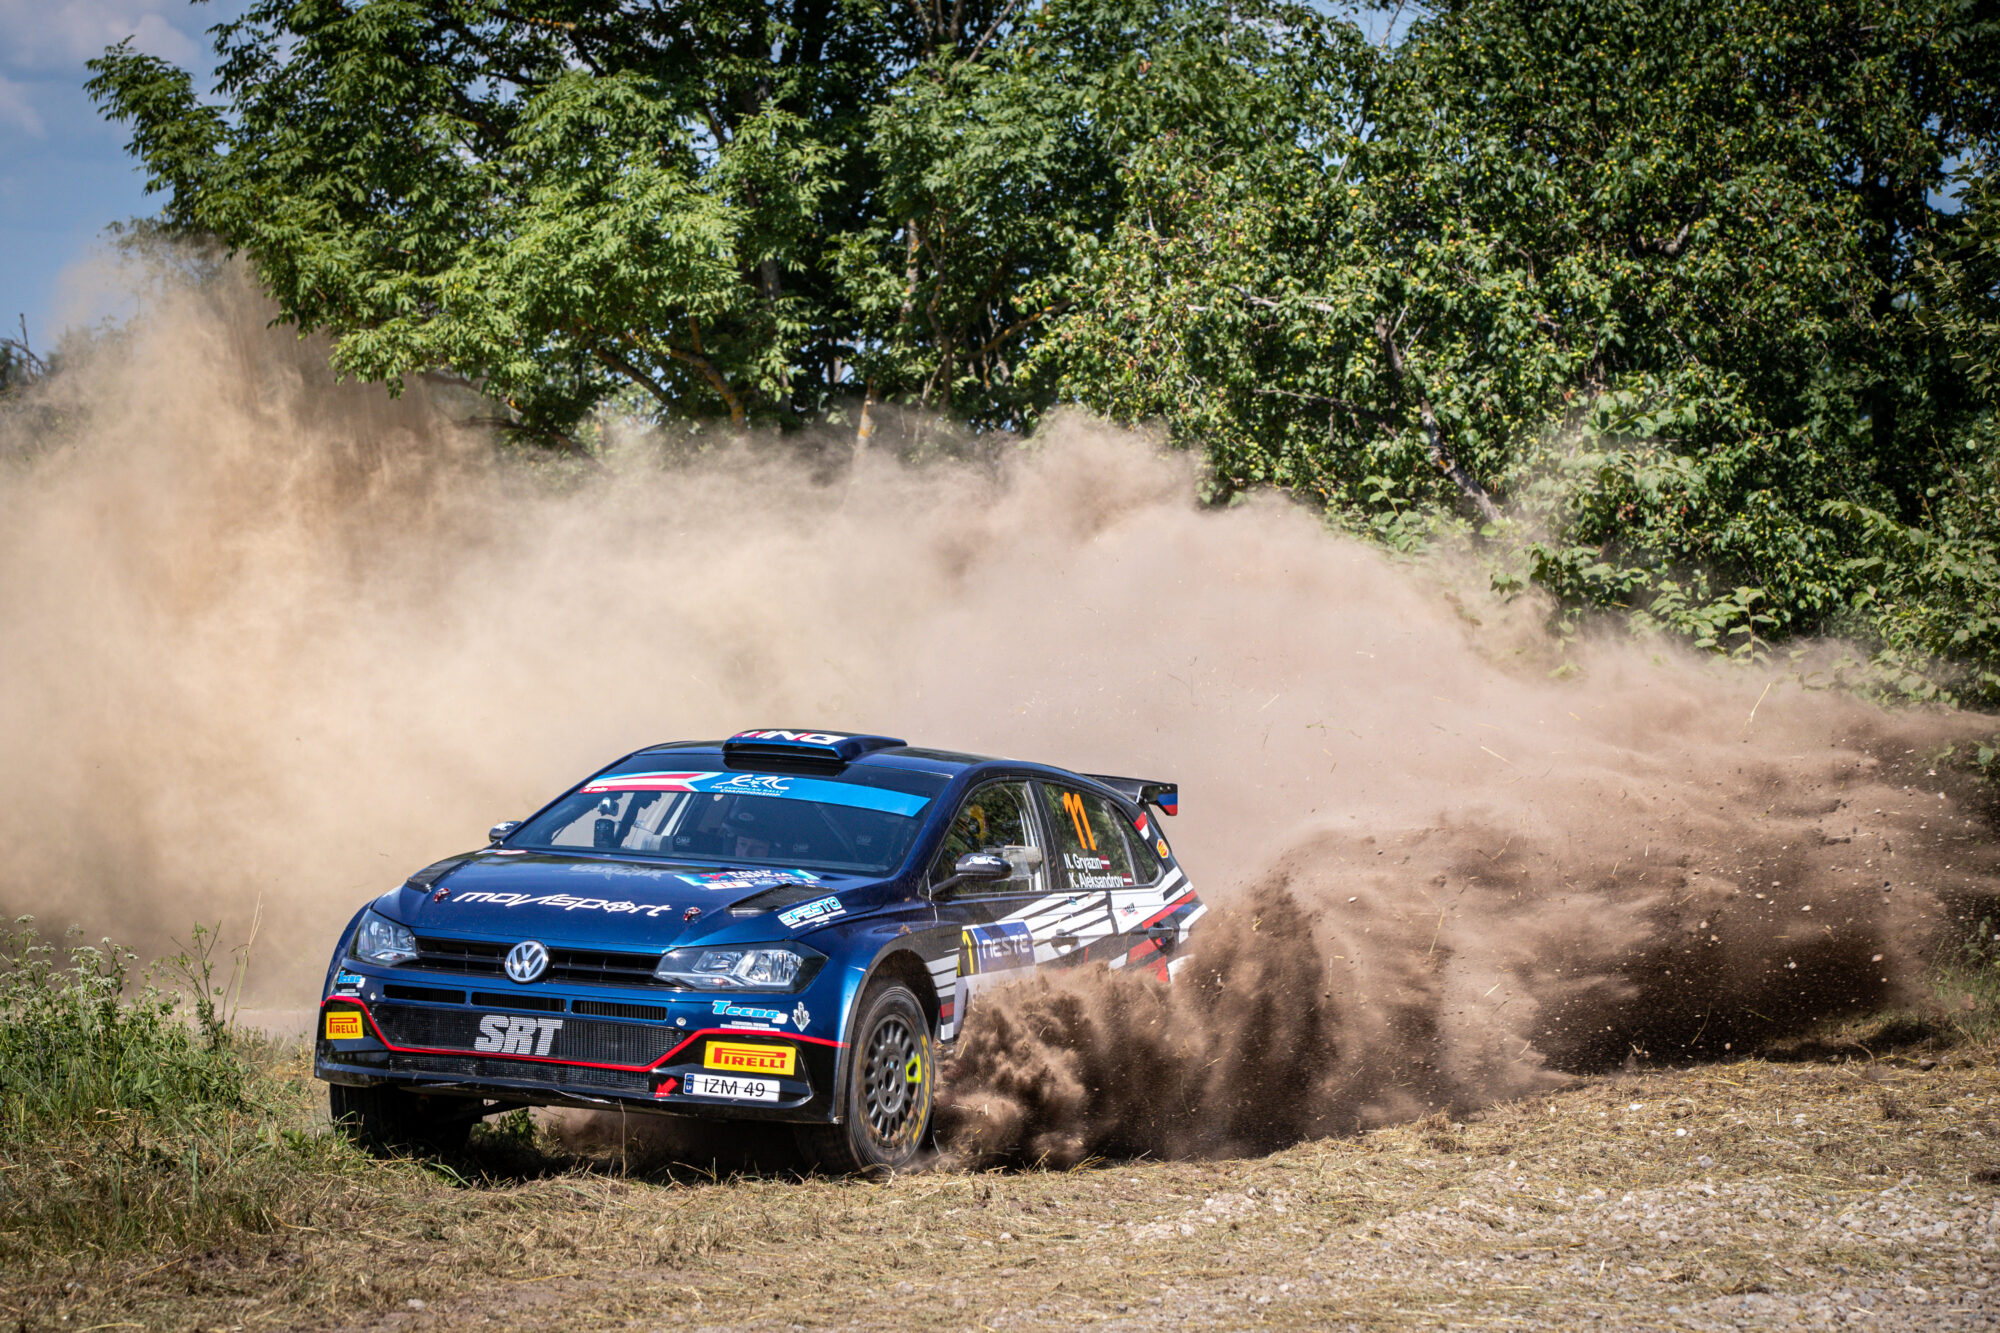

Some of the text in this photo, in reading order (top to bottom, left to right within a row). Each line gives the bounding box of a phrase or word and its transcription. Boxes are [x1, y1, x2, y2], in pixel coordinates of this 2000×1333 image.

[1062, 791, 1097, 851] 11
[1072, 853, 1103, 873] Gryazin
[1079, 872, 1124, 888] Aleksandrov
[778, 896, 842, 926] EFESTO
[982, 934, 1030, 959] NESTE
[329, 1017, 358, 1034] PIRELLI
[474, 1015, 563, 1056] SRT
[713, 1047, 787, 1069] PIRELLI
[704, 1078, 766, 1098] IZM 49
